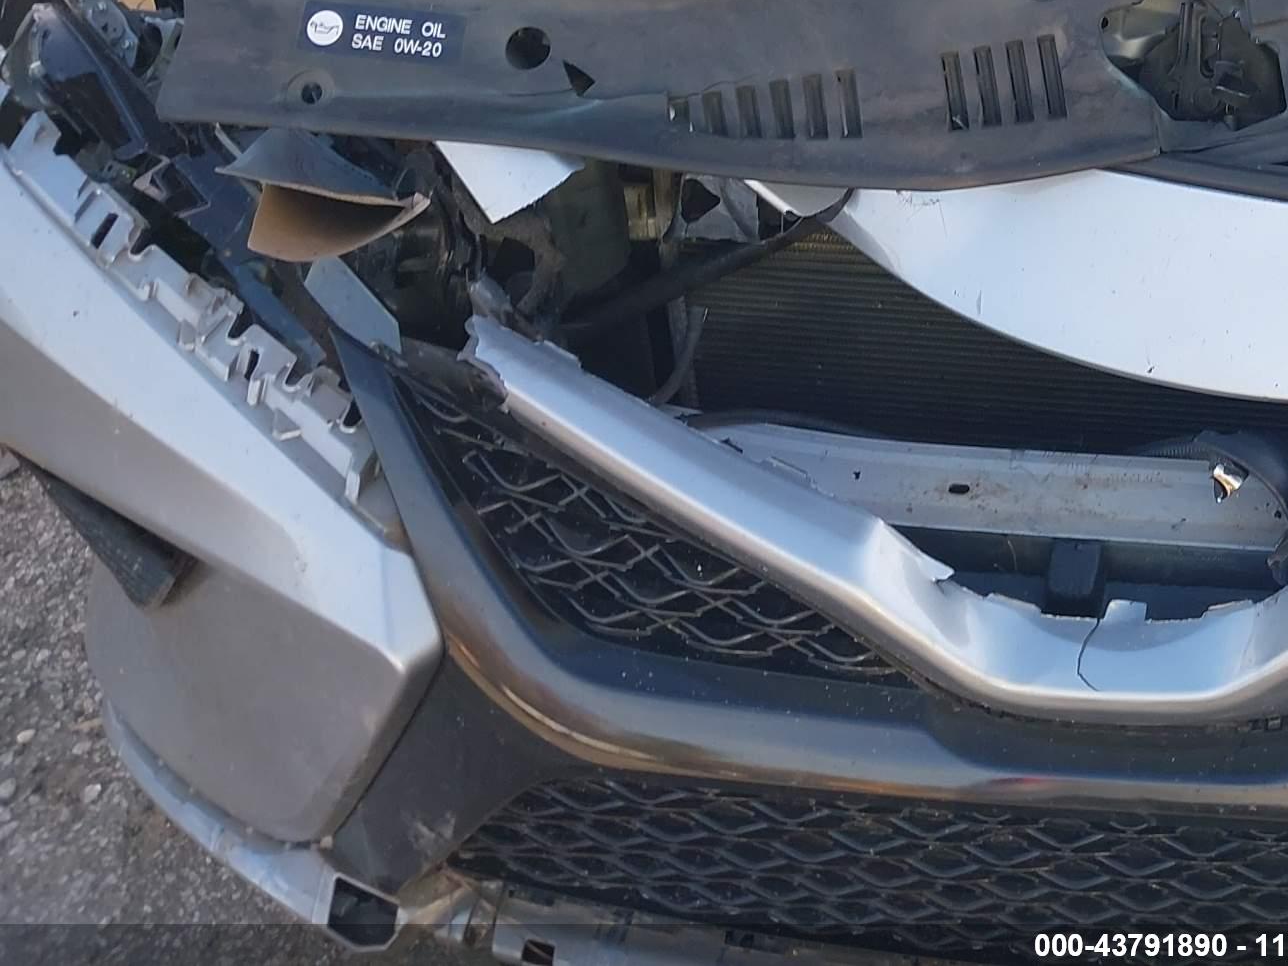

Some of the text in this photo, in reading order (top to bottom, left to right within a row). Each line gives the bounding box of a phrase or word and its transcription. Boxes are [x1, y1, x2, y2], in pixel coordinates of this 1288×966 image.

[354, 14, 447, 39] ENGINE OIL
[351, 33, 443, 58] SAE 0W-20
